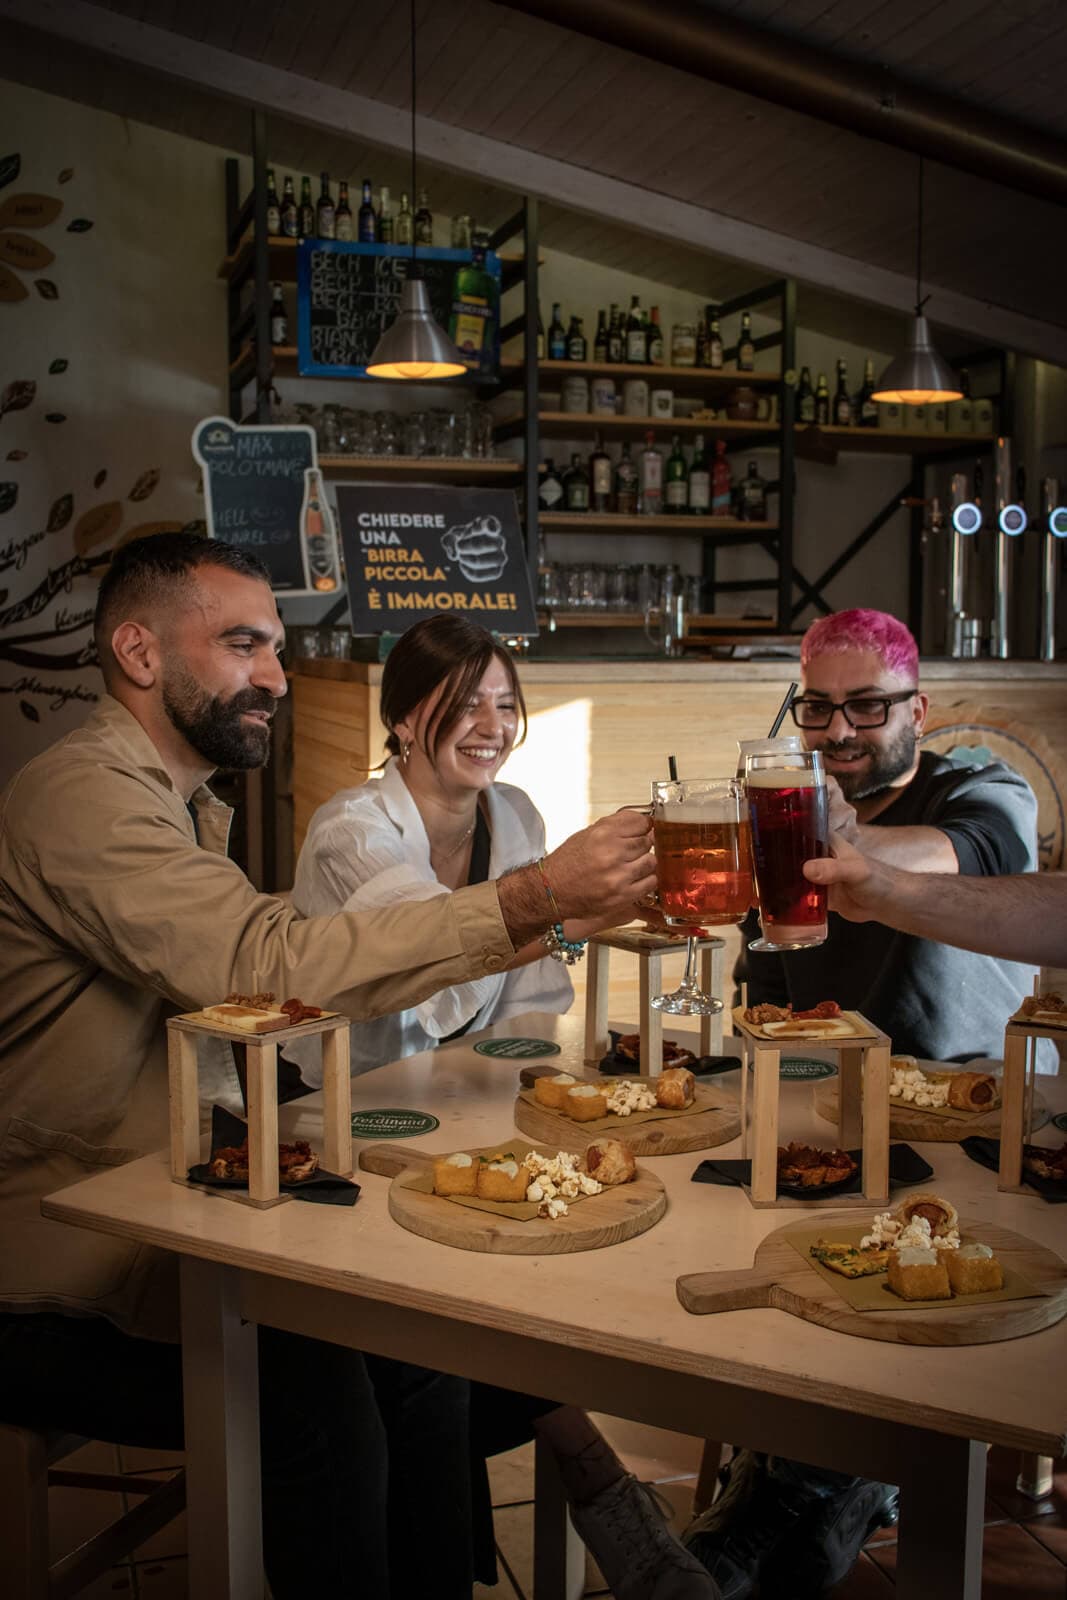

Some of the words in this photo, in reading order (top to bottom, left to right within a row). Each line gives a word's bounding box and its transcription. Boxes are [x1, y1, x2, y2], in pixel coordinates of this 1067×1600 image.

[374, 255, 408, 279] ICE
[236, 434, 273, 459] MAX
[358, 513, 446, 528] CHIEDERE
[359, 530, 402, 545] UNA
[368, 588, 382, 609] È
[387, 591, 517, 610] IMMORALE!
[352, 1115, 427, 1127] Ferdinand
